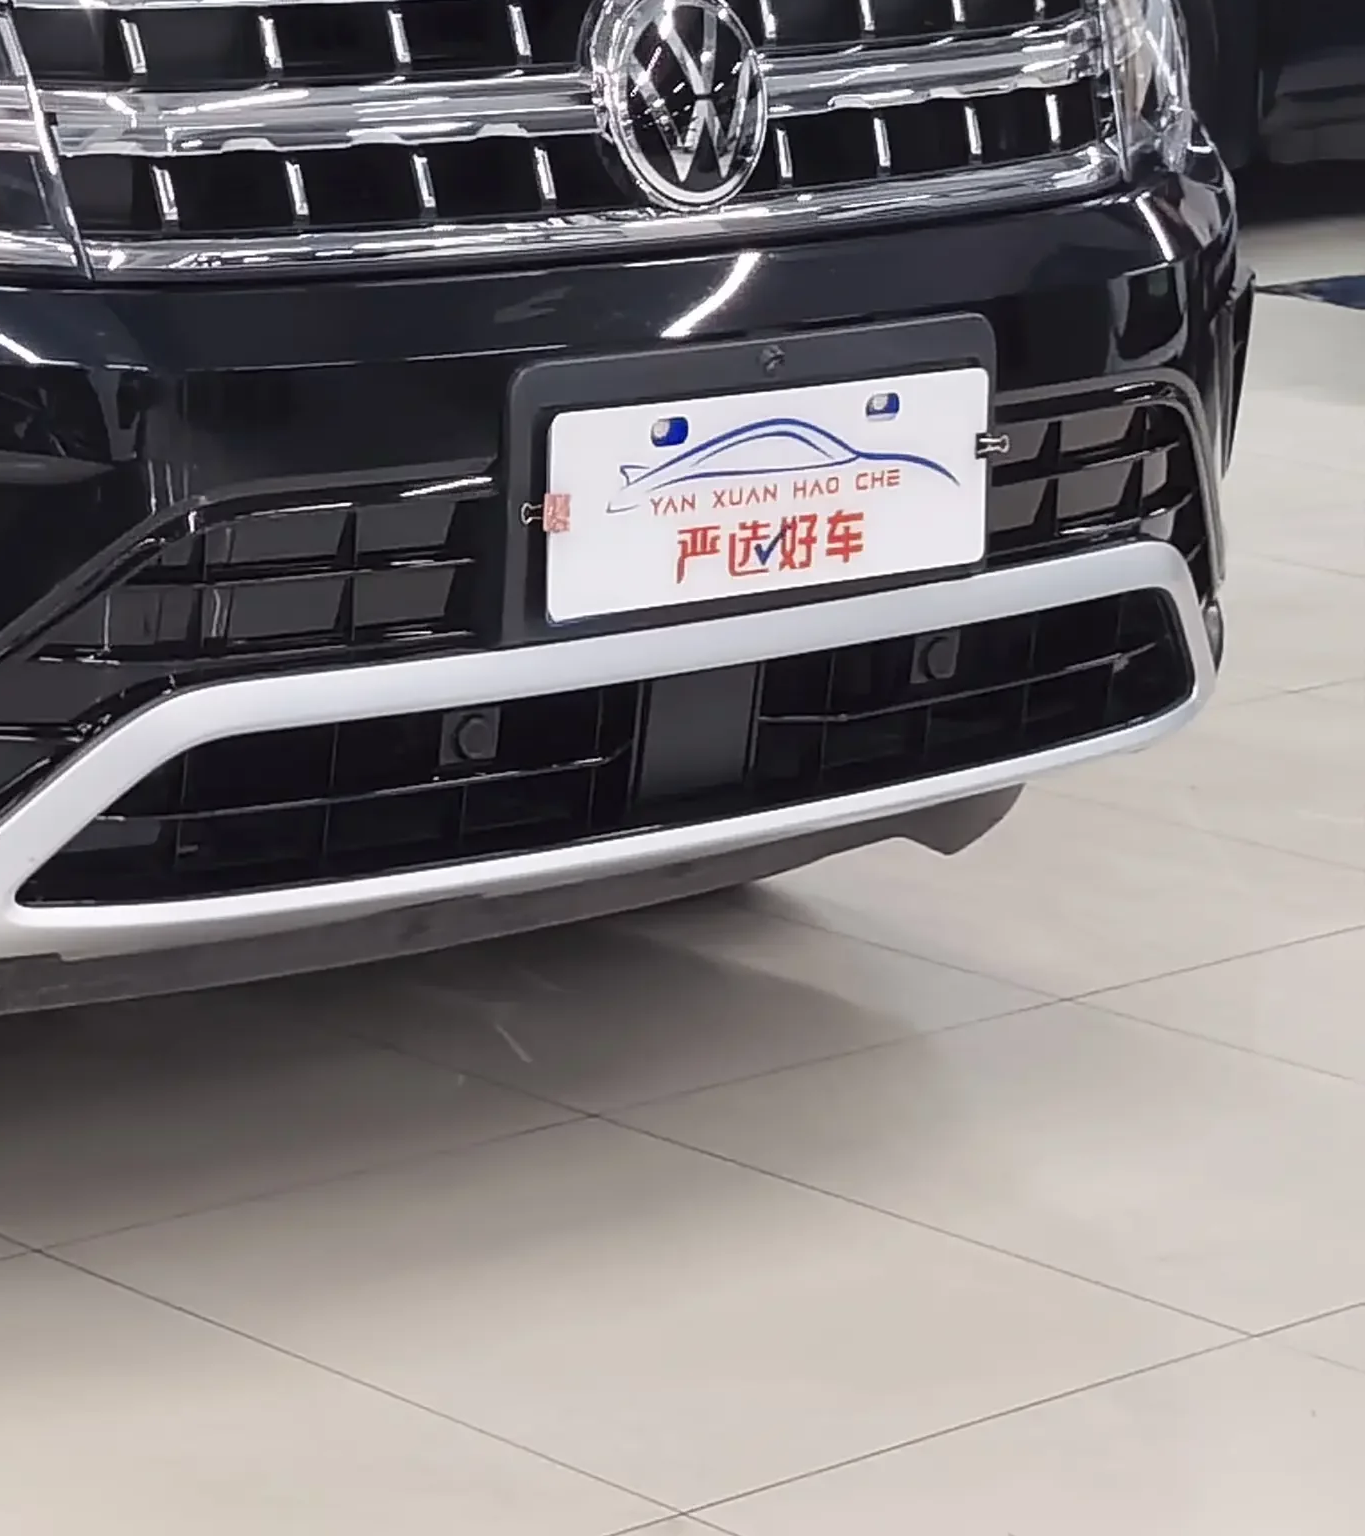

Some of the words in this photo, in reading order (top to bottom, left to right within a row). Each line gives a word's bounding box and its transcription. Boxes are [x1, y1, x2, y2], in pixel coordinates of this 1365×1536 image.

[649, 492, 697, 517] YAN
[712, 483, 780, 510] XUAN
[793, 474, 840, 498] HAO
[855, 468, 901, 491] CHE
[675, 509, 865, 584] 严选好车
